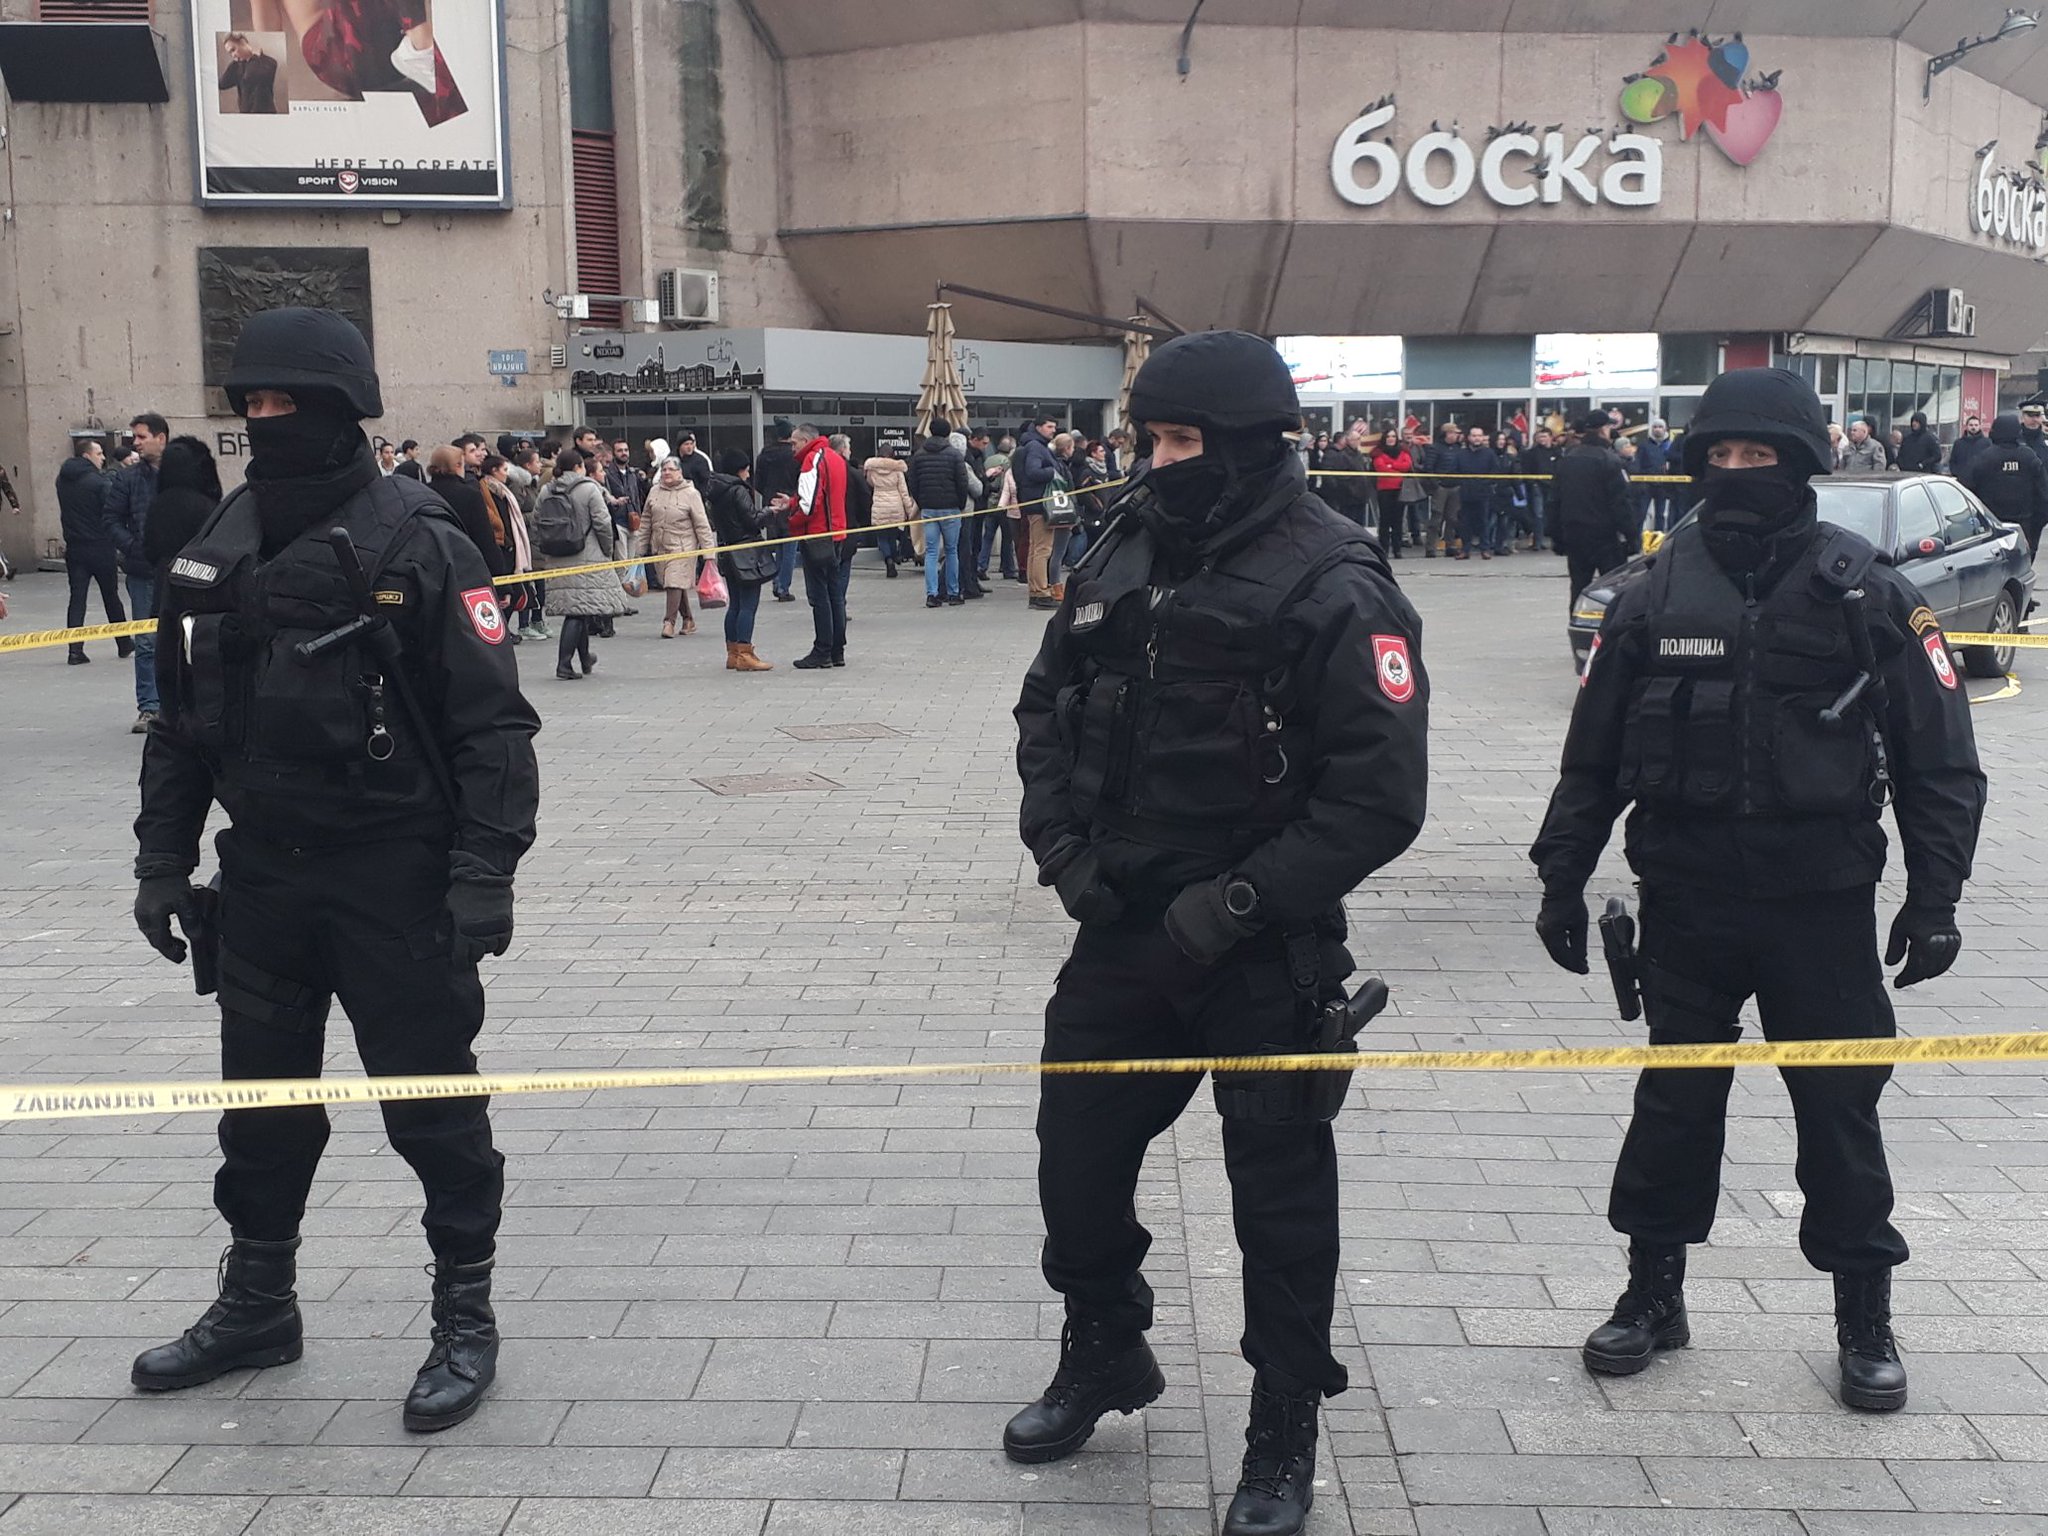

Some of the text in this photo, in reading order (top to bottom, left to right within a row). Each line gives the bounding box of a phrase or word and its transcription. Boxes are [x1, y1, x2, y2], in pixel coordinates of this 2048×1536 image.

[315, 158, 496, 170] HERE TO CREATE
[1331, 104, 1664, 206] боска
[297, 176, 398, 186] SPORT VISION
[1659, 638, 1725, 657] ПОЛИЦИЈА
[13, 1090, 156, 1113] ZABRANJEN
